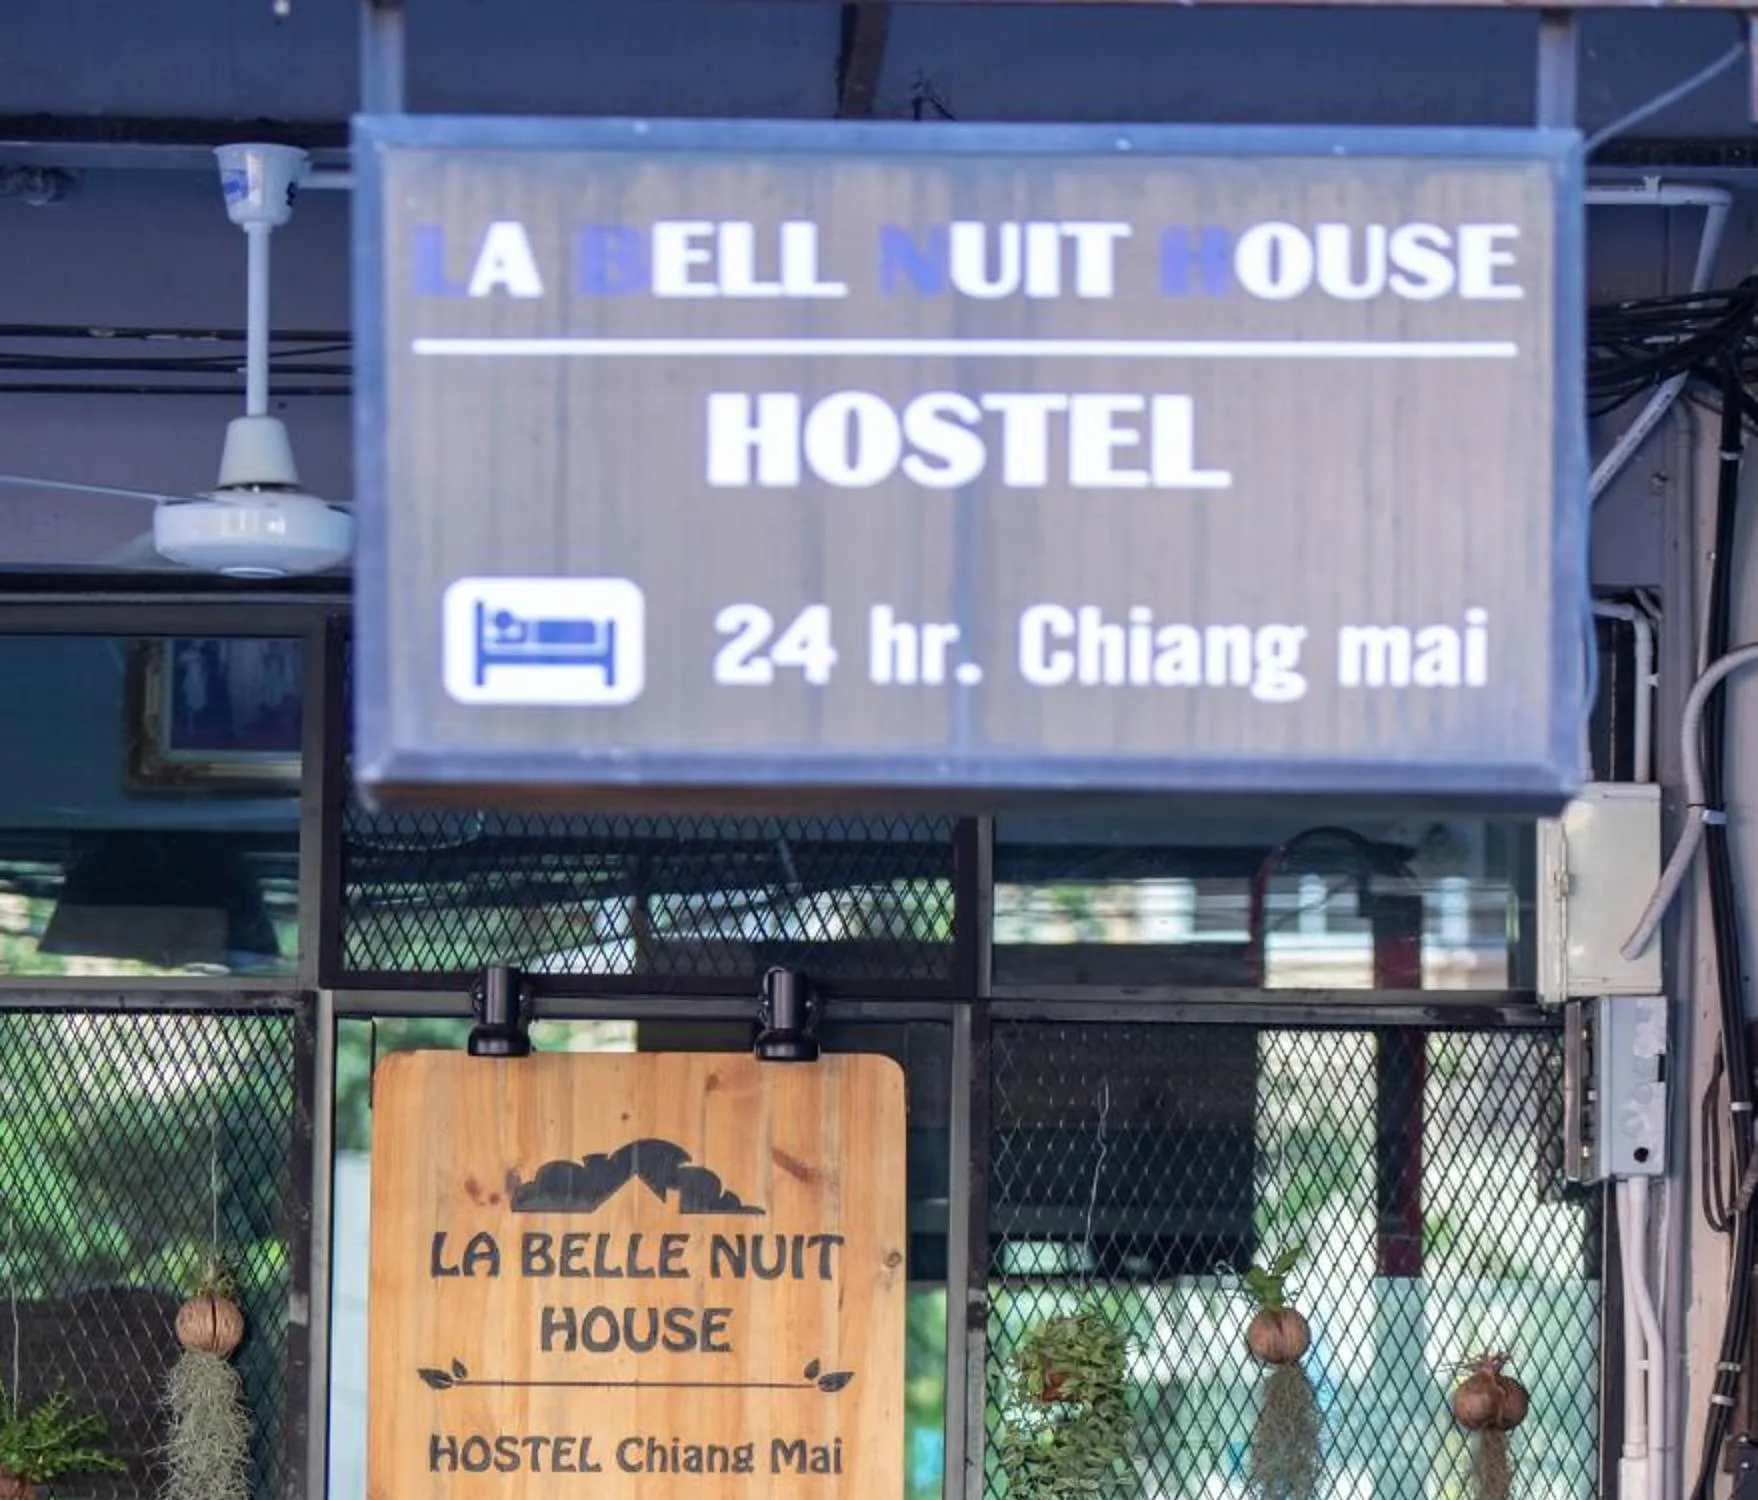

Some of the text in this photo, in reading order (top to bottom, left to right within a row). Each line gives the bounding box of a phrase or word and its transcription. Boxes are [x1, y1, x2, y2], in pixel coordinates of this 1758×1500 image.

[413, 221, 1525, 301] LA BELL NUIT HOUSE
[705, 391, 1232, 489] HOSTEL
[713, 603, 1487, 703] 24 hr. Chiang mai
[430, 1231, 845, 1281] LA BELLE NUIT
[540, 1306, 733, 1353] HOUSE
[428, 1433, 844, 1476] HOSTEL Chiang Mai
